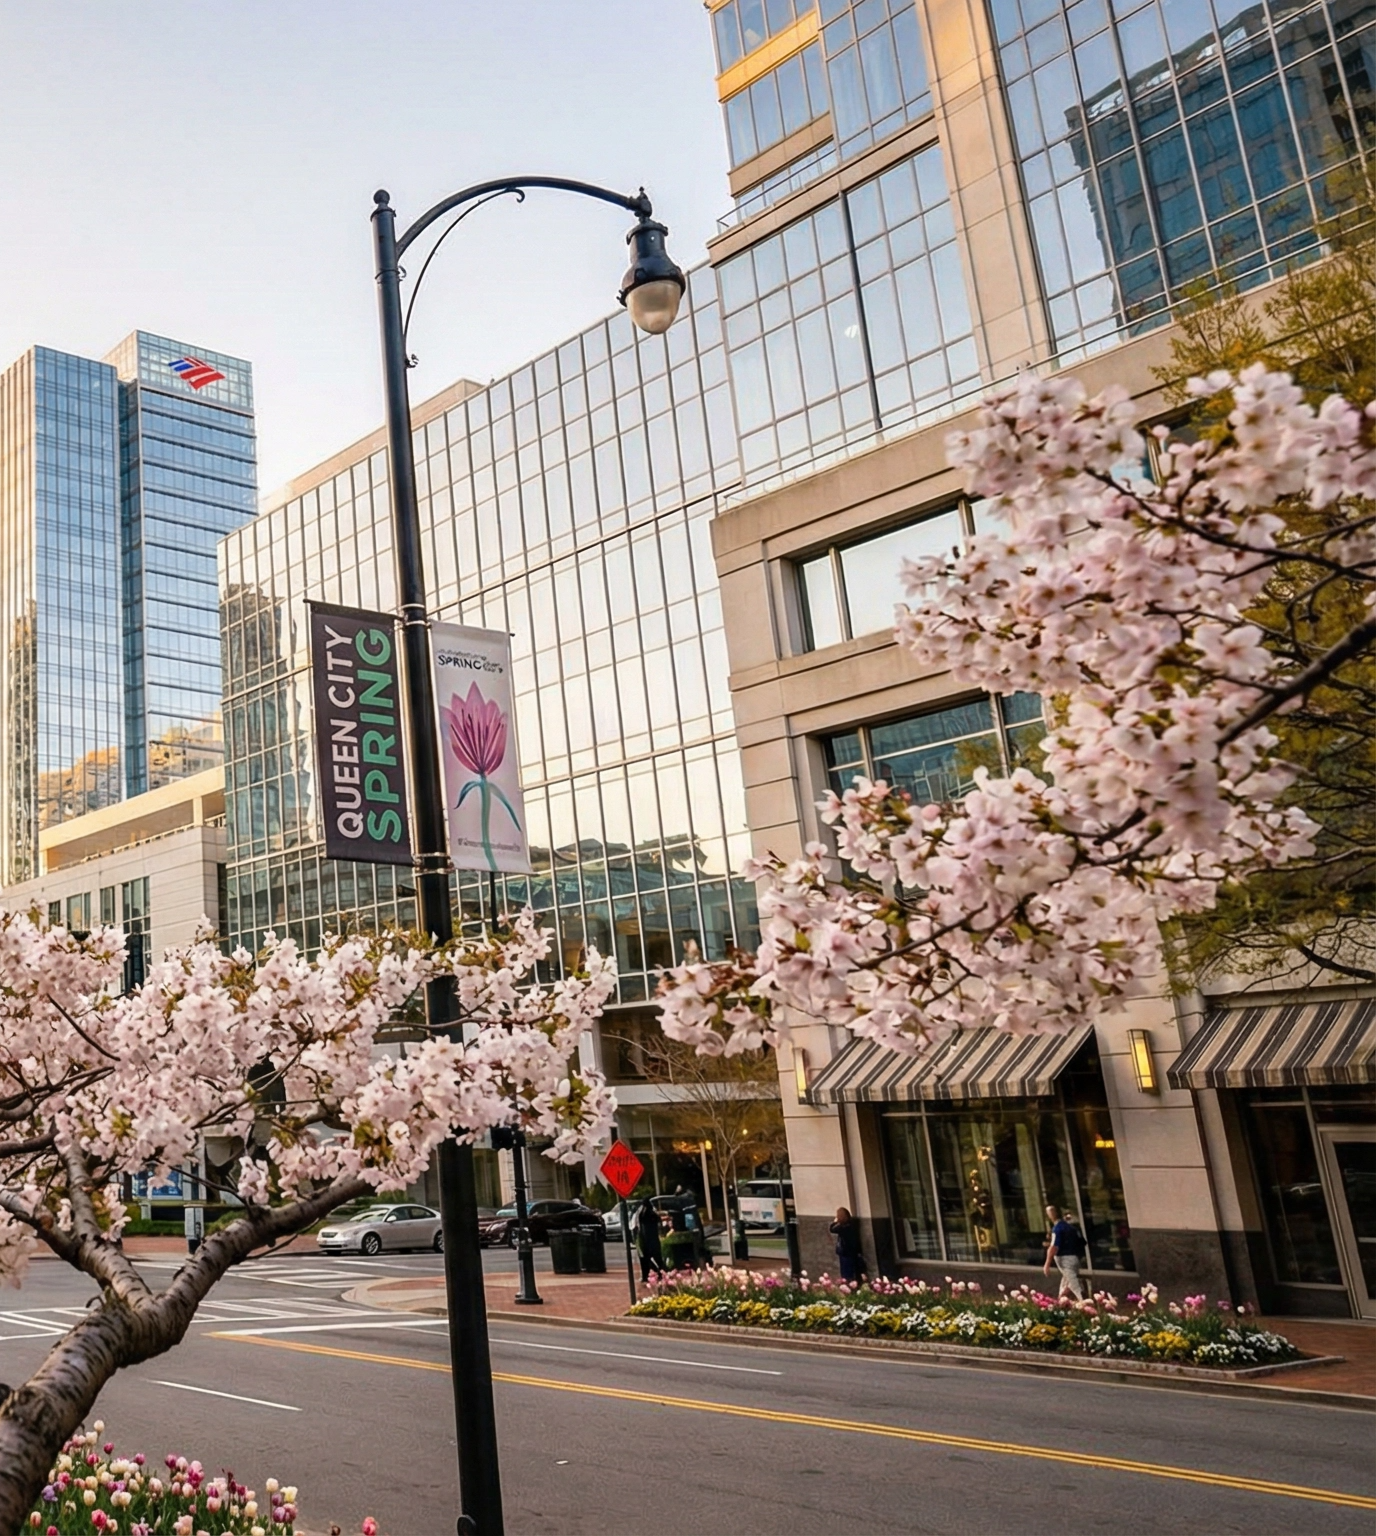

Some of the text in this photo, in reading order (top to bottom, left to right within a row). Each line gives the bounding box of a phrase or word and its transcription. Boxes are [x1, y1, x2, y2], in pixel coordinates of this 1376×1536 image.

[324, 624, 364, 839] QUEEN CITY
[355, 629, 402, 843] SPRING
